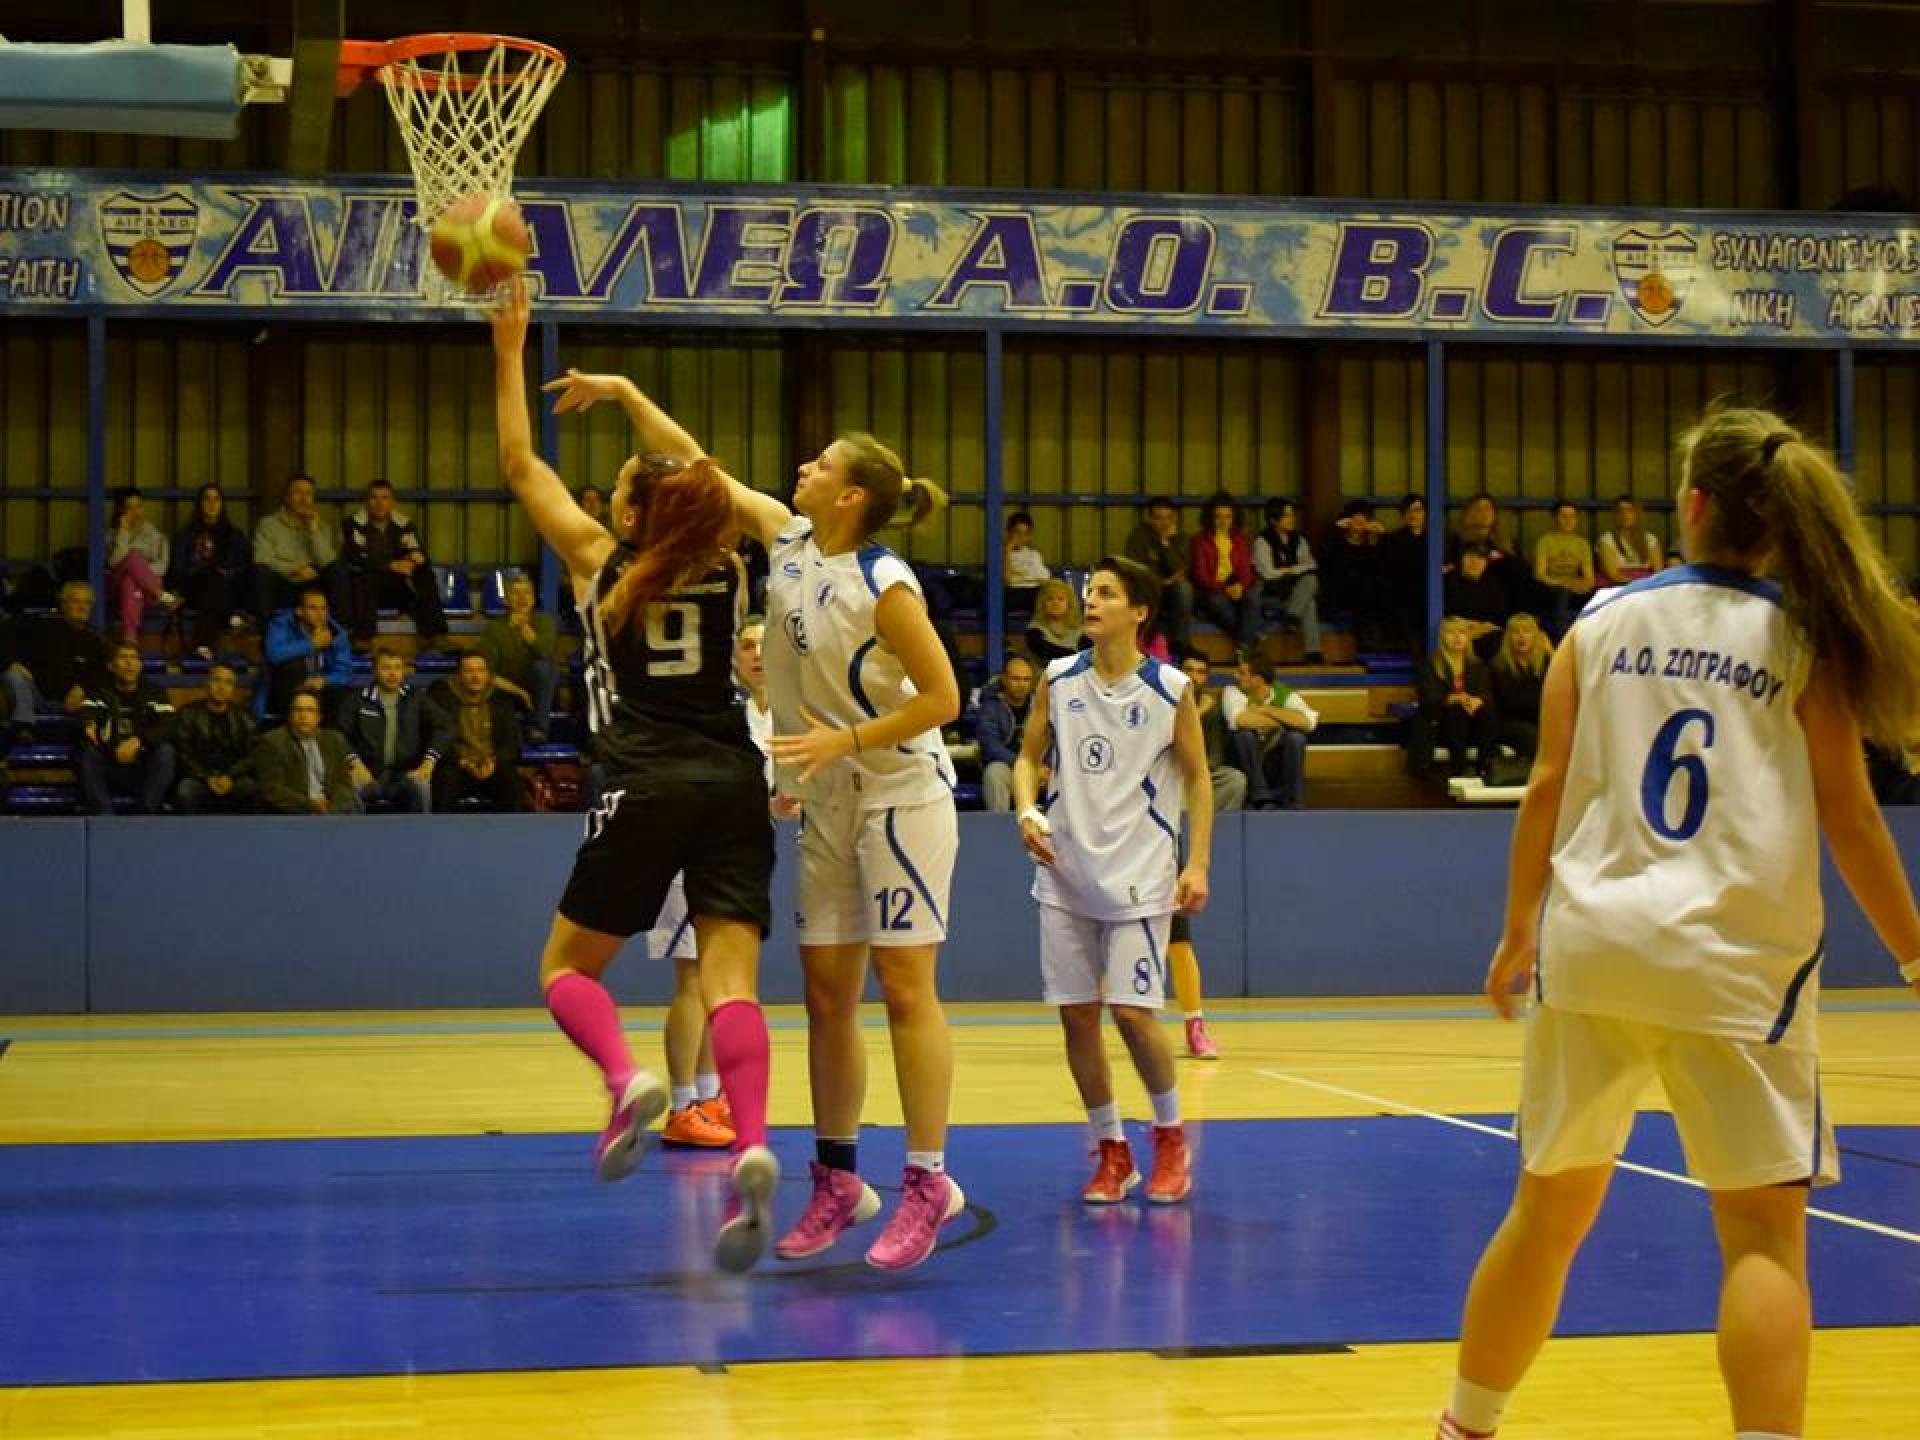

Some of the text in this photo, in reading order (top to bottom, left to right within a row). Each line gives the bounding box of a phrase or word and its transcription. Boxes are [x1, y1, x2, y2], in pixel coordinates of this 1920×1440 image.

[0, 192, 71, 232] TION
[1315, 218, 1615, 324] B.C.
[647, 602, 701, 676] 9
[1087, 741, 1103, 769] 8
[1640, 707, 1715, 841] 6
[874, 887, 916, 931] 12
[1133, 957, 1151, 994] 8
